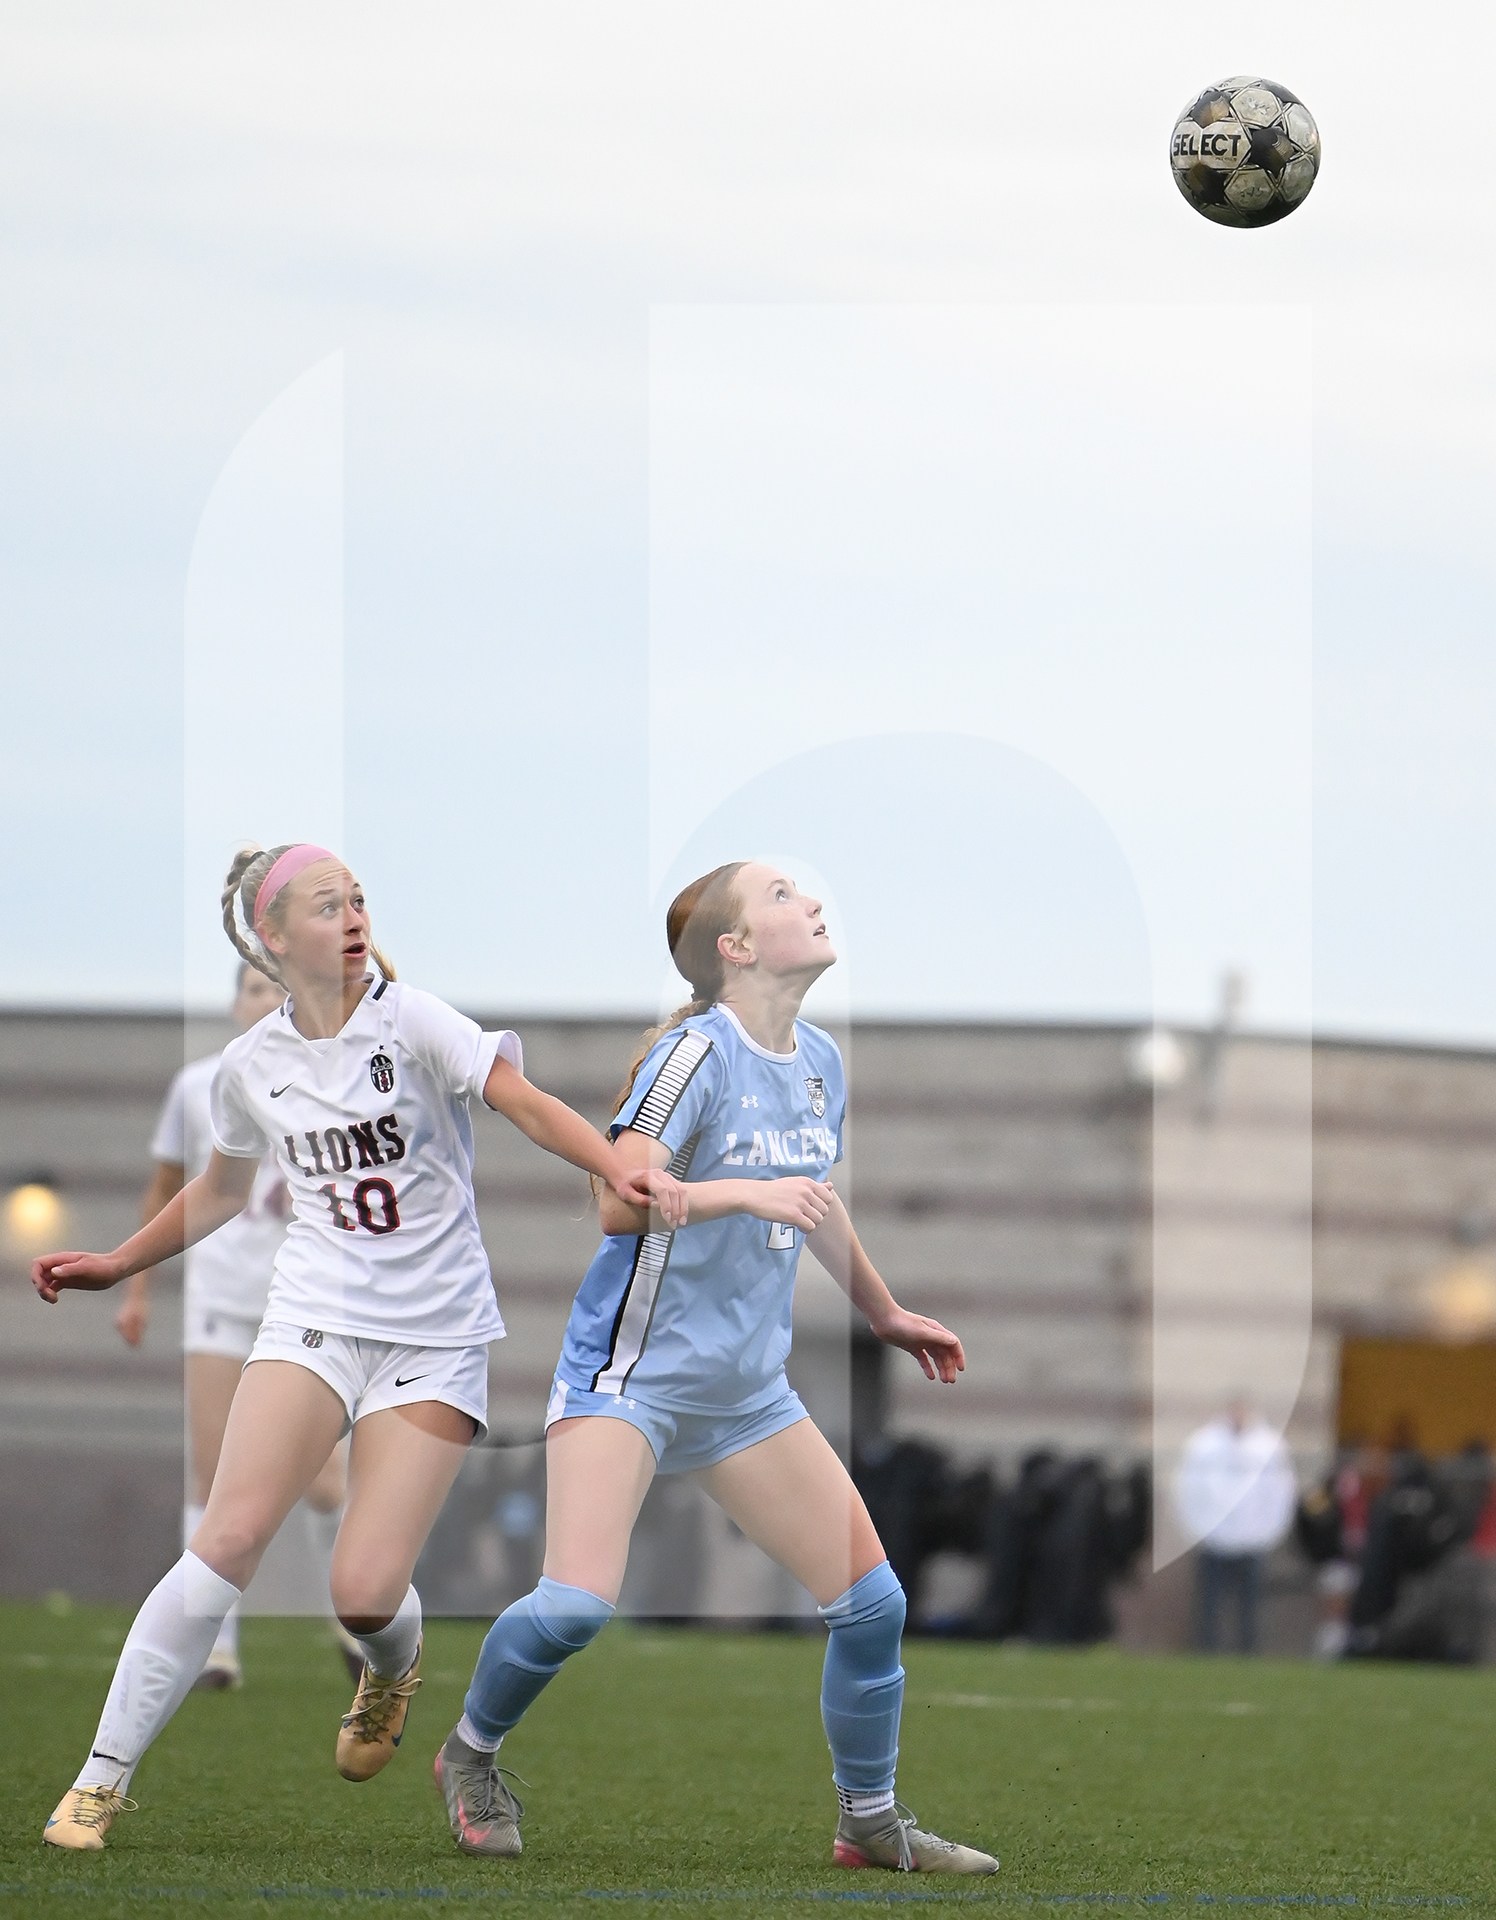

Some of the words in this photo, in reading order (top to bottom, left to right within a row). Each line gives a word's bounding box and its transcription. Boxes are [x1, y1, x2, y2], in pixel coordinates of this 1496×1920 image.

[1173, 134, 1242, 157] SELECT
[284, 1113, 406, 1178] LIONS
[722, 1127, 838, 1166] LANCERS
[317, 1177, 400, 1235] 10
